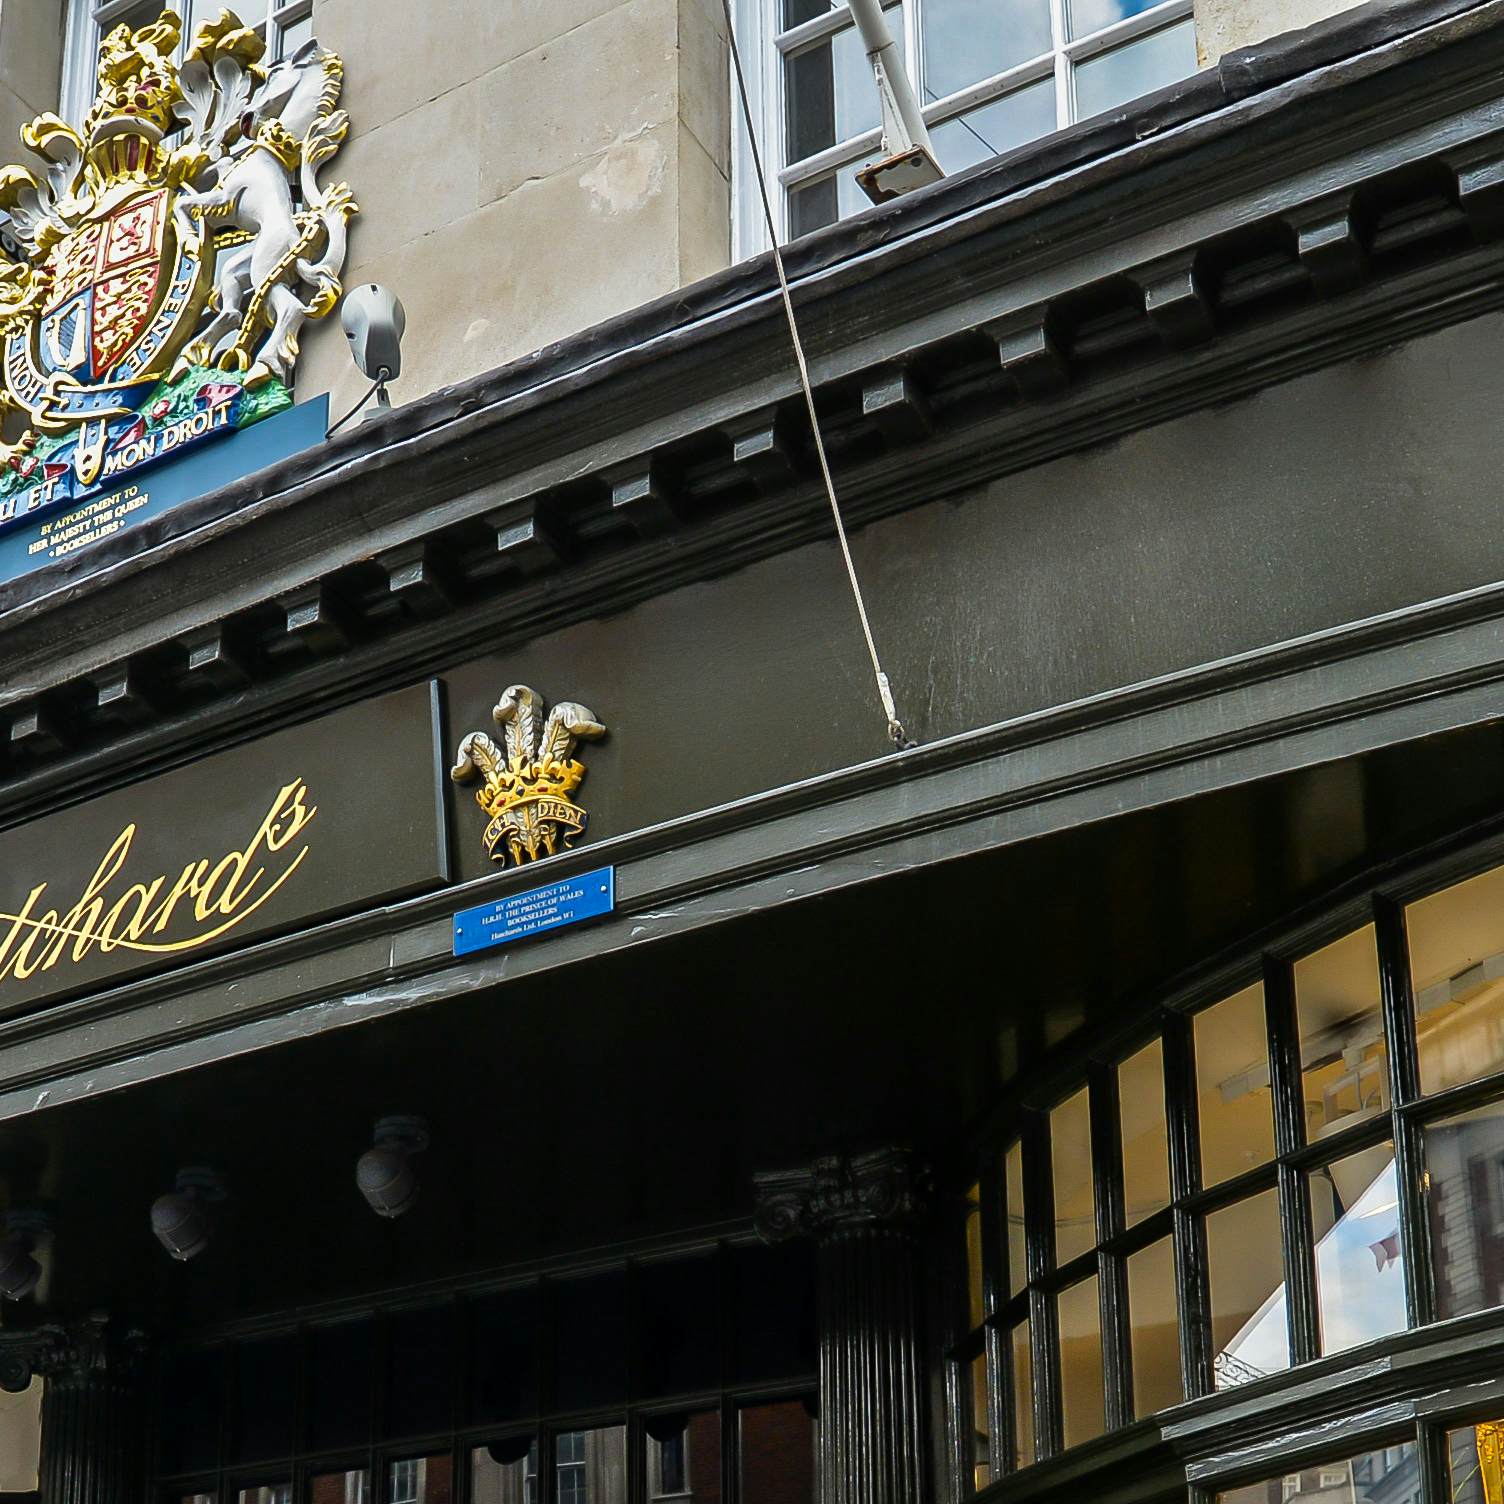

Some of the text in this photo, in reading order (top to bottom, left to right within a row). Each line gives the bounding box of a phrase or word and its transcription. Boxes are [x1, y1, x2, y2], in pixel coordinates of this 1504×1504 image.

[128, 279, 191, 372] PENSE
[102, 401, 231, 476] MON DROIT
[29, 477, 59, 510] ET
[41, 486, 137, 535] BY APPOINTMENT TO
[28, 494, 148, 554] HER MAJESTY THE QUEEN
[56, 521, 118, 556] BOOKSELLERS
[484, 800, 582, 846] ICH DIEN
[505, 909, 519, 918] THE
[521, 901, 547, 914] PRINCE
[548, 897, 558, 906] OF
[559, 890, 584, 902] WALES
[507, 889, 556, 908] APPOINTMENT
[559, 885, 570, 893] TO
[507, 907, 557, 926] BOOKSELLERS
[538, 916, 562, 927] London
